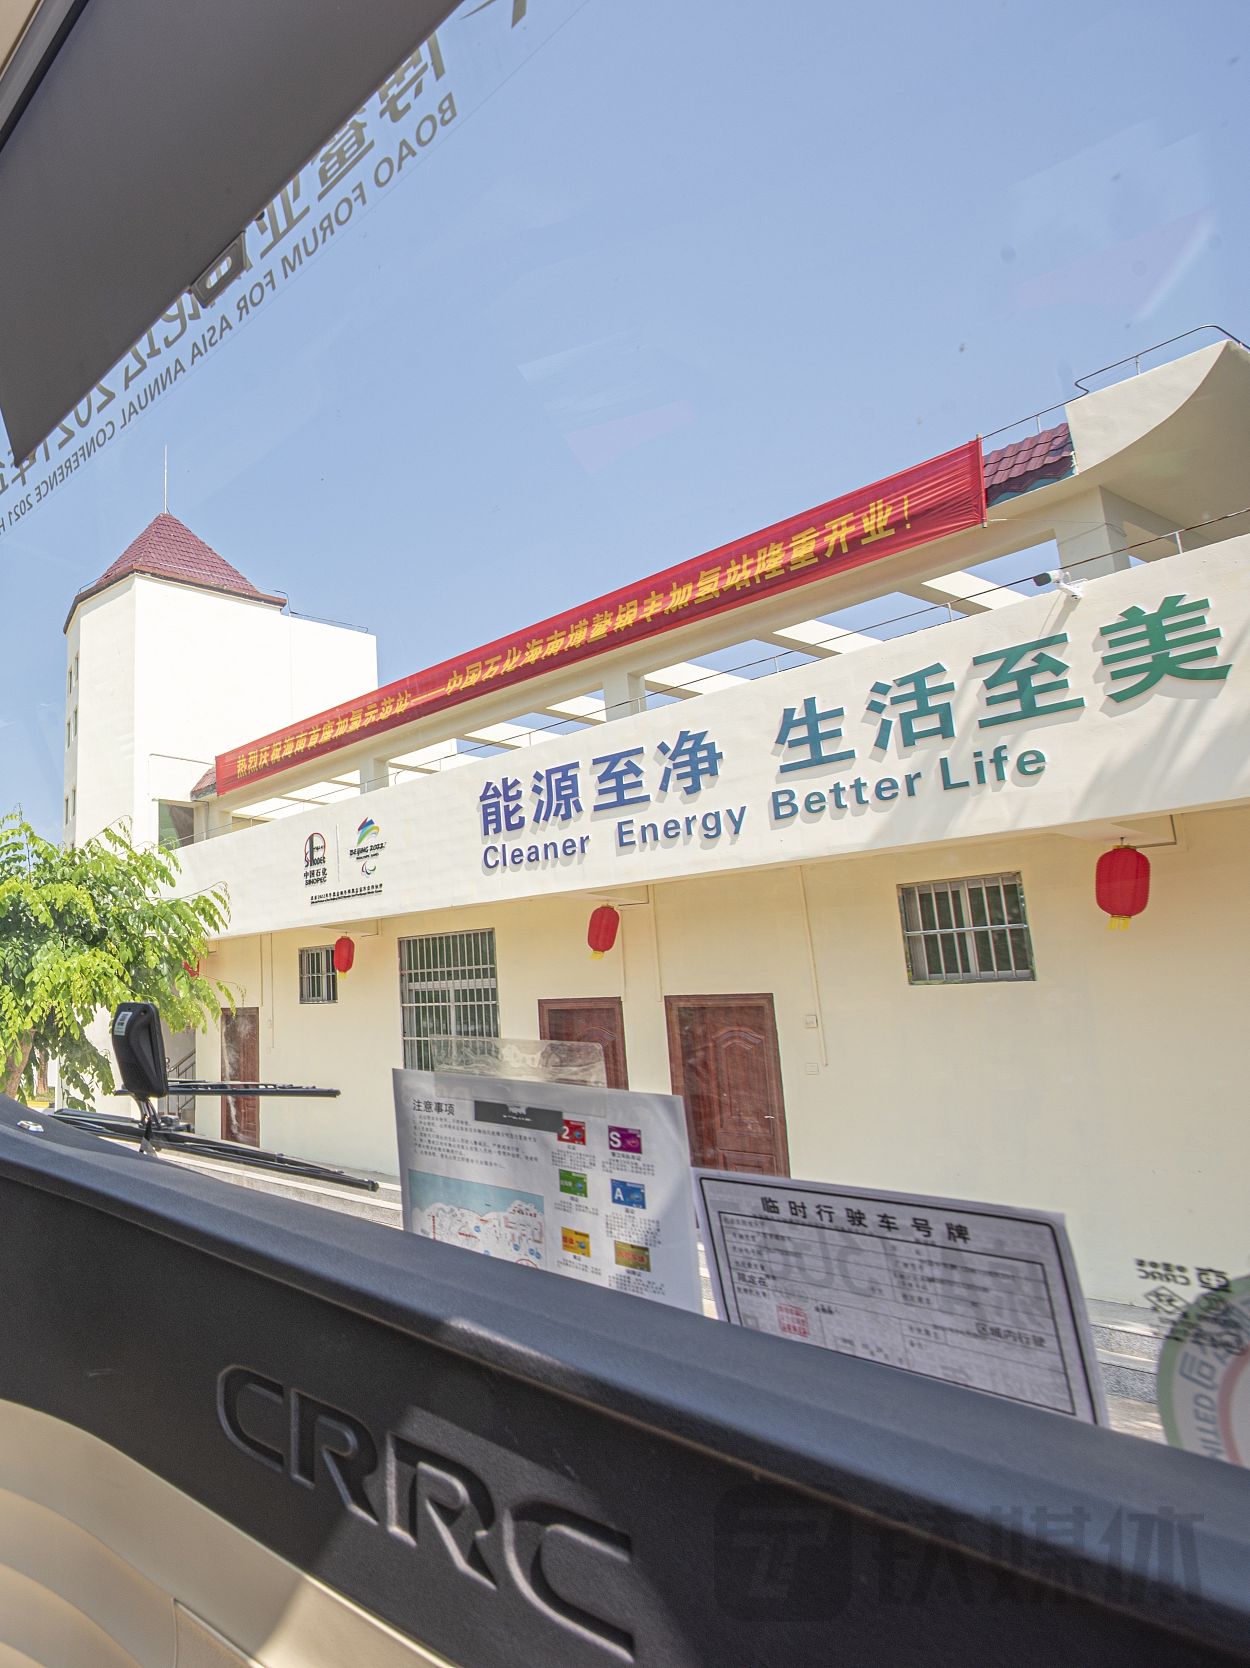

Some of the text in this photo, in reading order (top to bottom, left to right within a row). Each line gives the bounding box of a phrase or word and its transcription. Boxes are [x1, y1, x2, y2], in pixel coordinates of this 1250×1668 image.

[479, 593, 1233, 837] 能源至净 生活至美
[482, 745, 1047, 870] Cleaner Energy Better Life
[305, 875, 327, 886] SINOPEC
[412, 1099, 455, 1116] 注意事项
[609, 1131, 622, 1148] S
[614, 1187, 624, 1201] A
[760, 1196, 971, 1244] 临时行驶车号牌
[975, 1321, 1047, 1348] 区域内行驶
[217, 1364, 636, 1663] CRRC
